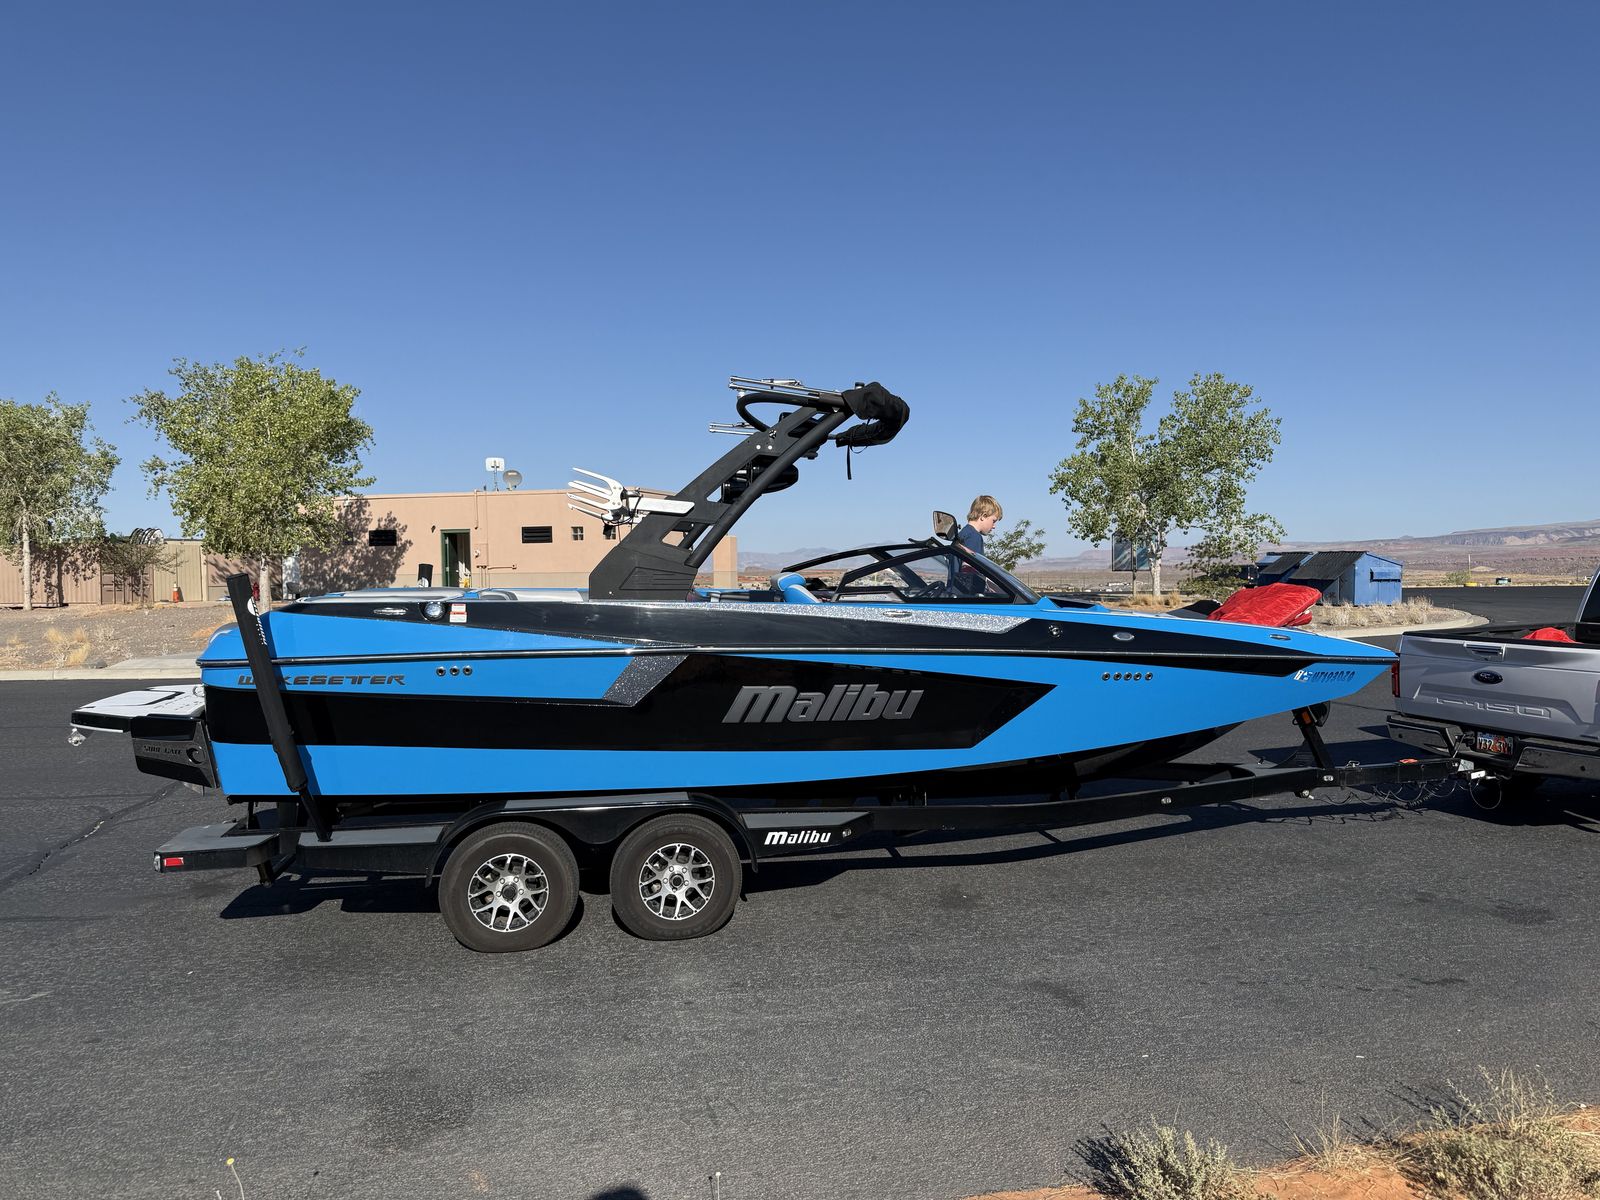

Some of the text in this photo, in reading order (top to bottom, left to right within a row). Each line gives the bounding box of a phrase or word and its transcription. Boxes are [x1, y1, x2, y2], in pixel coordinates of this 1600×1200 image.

[237, 674, 406, 686] WKESETTER
[721, 683, 924, 723] Malibu
[763, 830, 832, 845] Malibu
